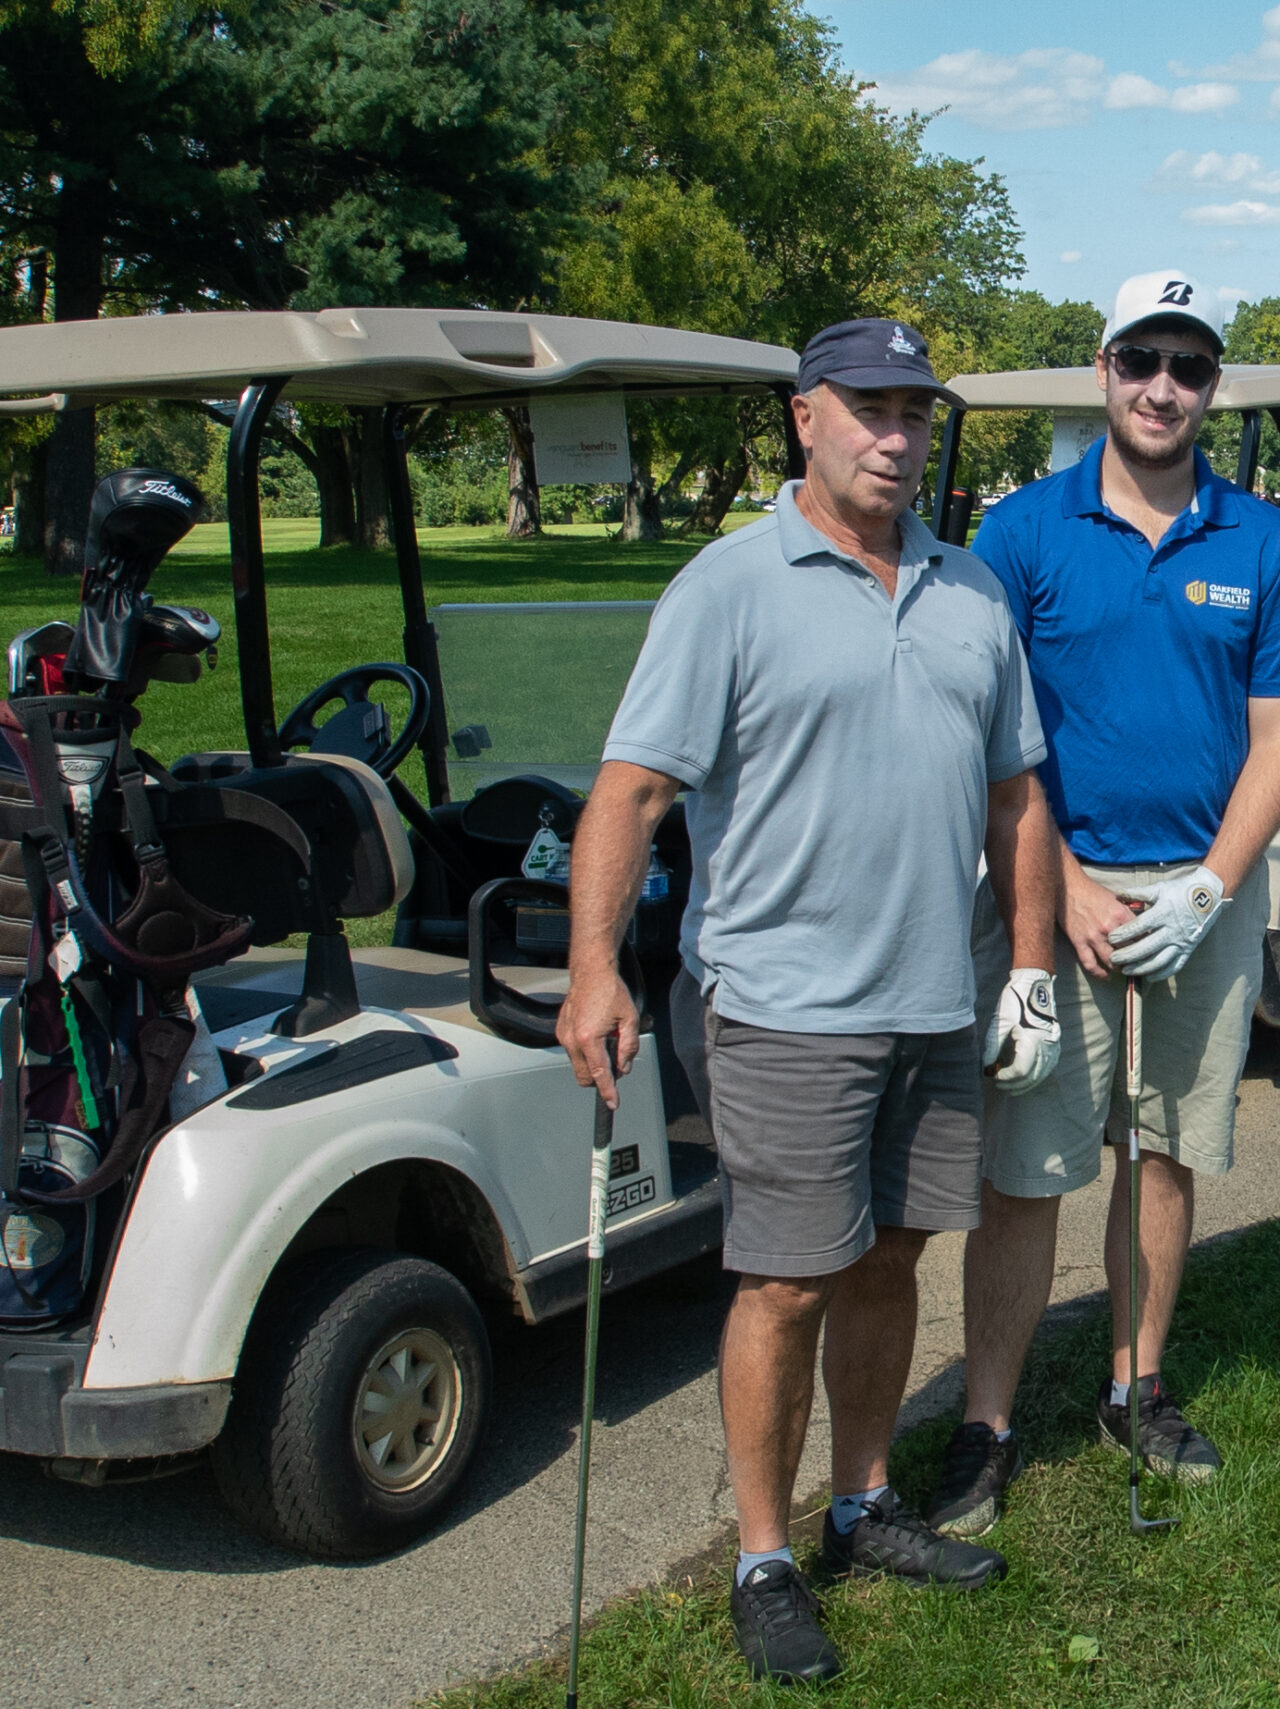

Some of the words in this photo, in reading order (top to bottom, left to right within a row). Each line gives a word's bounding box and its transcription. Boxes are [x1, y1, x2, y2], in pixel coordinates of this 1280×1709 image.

[138, 480, 192, 508] Titleist
[1209, 584, 1250, 596] OAKFIELD
[1209, 591, 1250, 605] WEALTH
